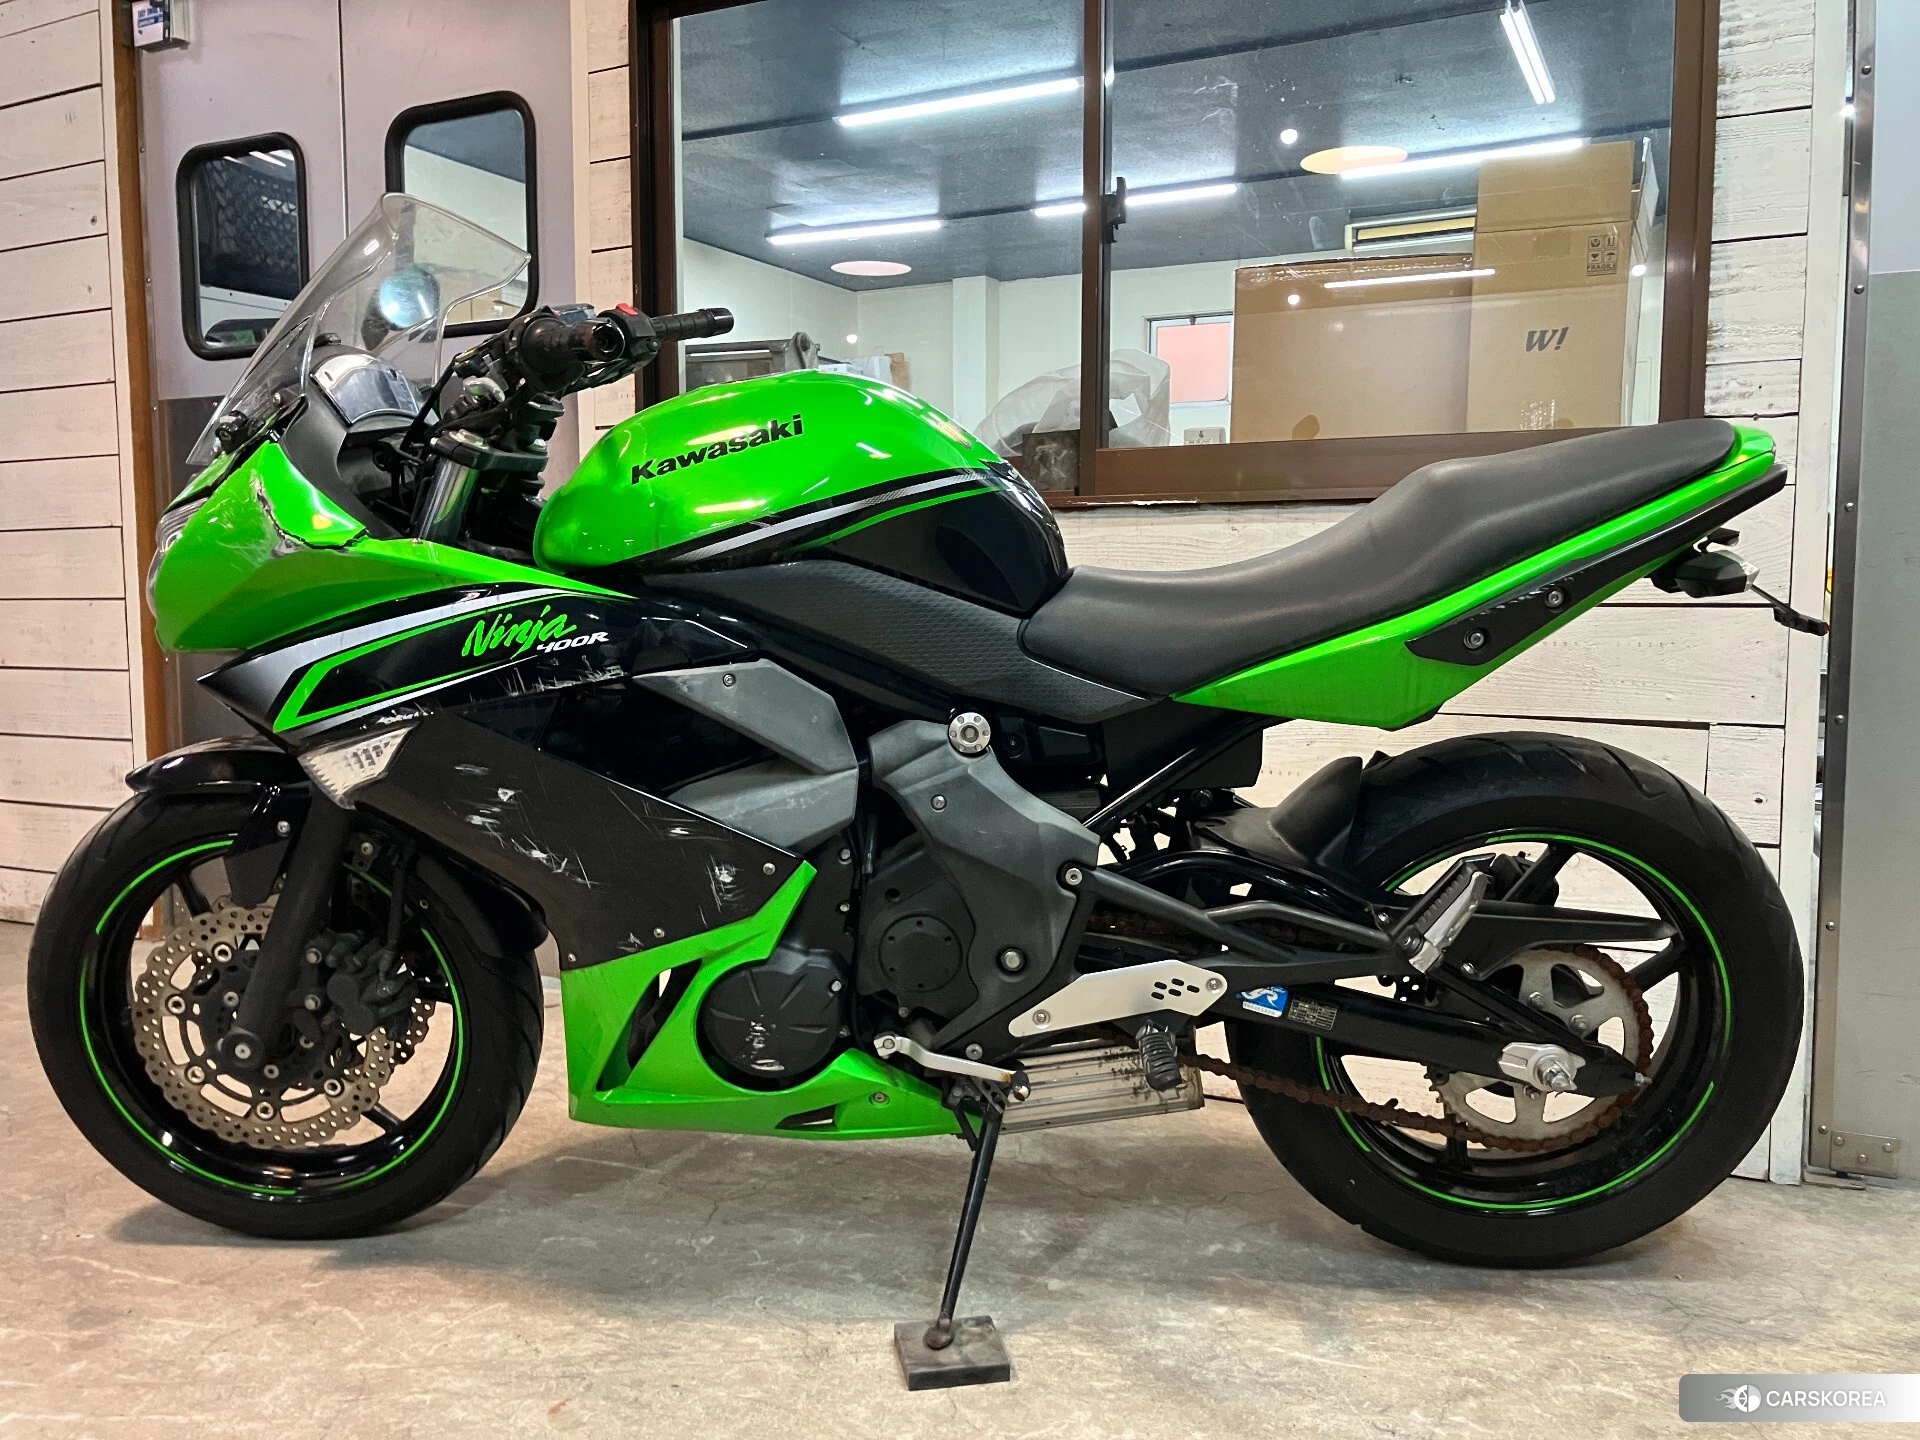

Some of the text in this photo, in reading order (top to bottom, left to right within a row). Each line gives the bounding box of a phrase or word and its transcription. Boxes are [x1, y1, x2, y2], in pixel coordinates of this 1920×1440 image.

[1526, 327, 1569, 352] W!
[631, 414, 804, 486] Kawasaki
[461, 605, 610, 660] Ninja 400R
